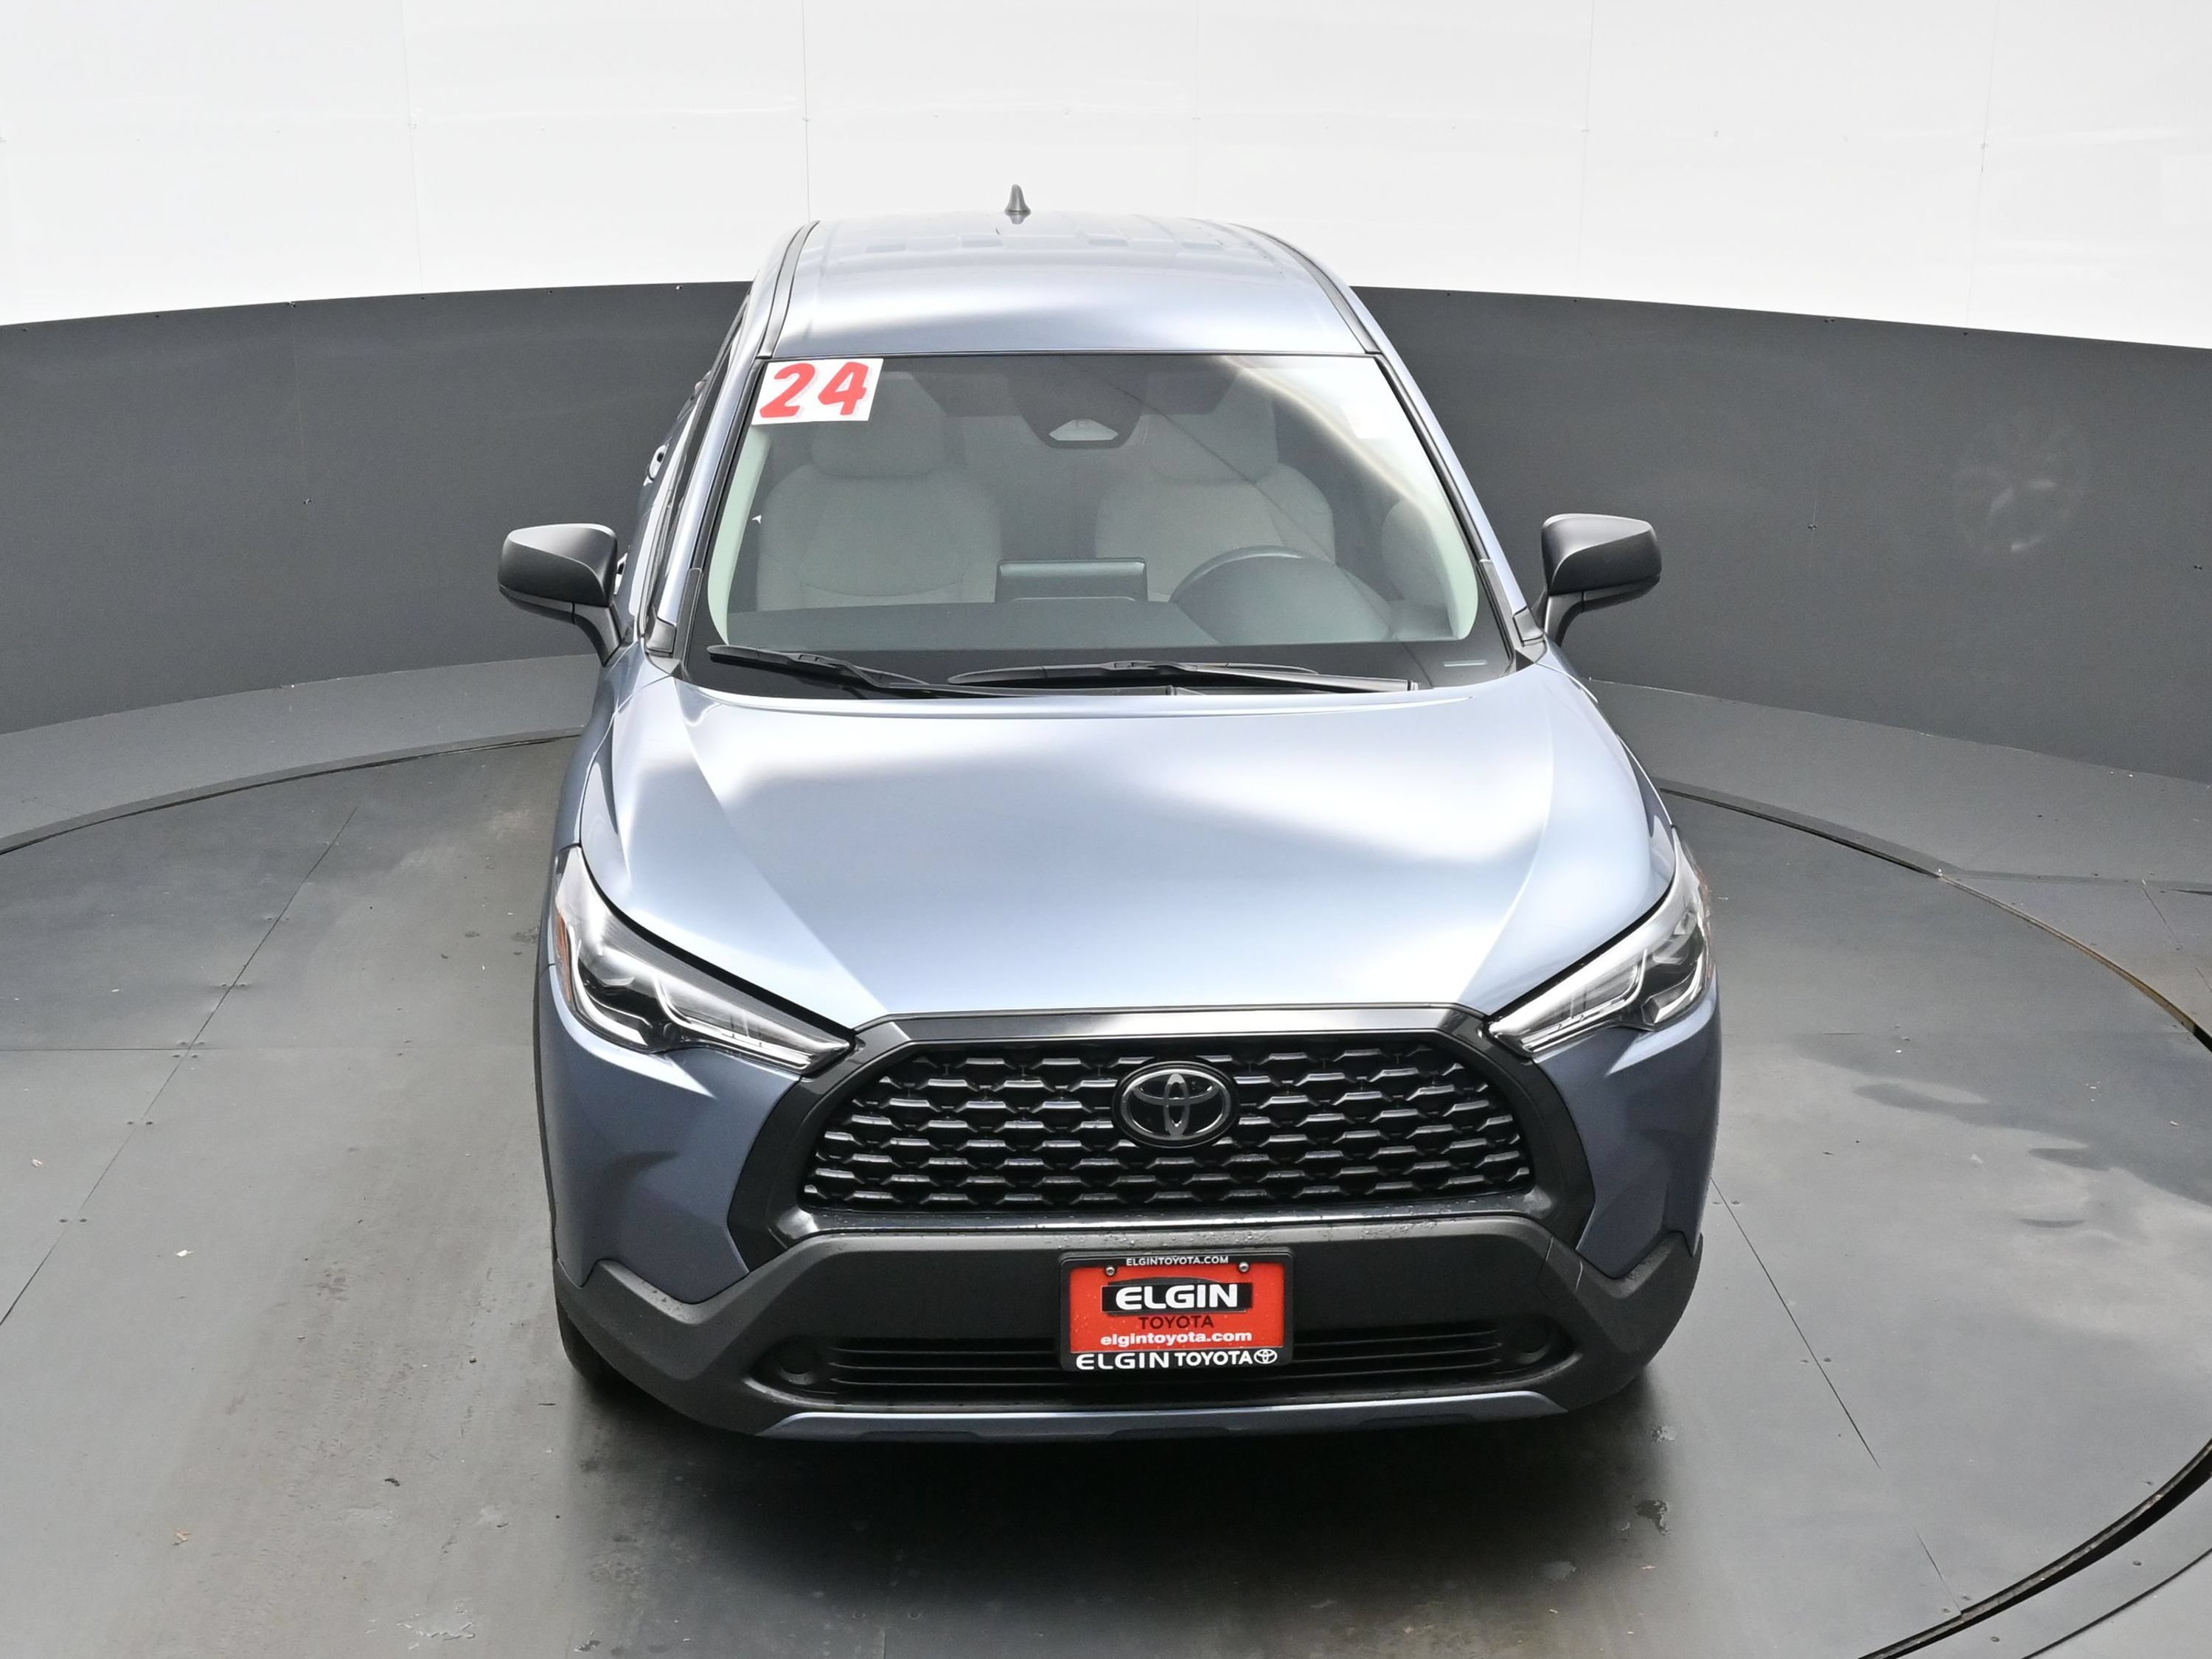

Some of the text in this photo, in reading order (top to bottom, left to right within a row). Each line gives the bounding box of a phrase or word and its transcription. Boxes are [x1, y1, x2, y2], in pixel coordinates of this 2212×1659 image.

[759, 361, 869, 418] 24
[1126, 1255, 1229, 1266] ELGINTOYOTA.COM
[1116, 1284, 1238, 1310] ELGIN
[1138, 1315, 1214, 1329] TOYOTA
[1100, 1332, 1252, 1348] elgintoyota.com
[1076, 1351, 1253, 1370] ELGIN TOYOTA
